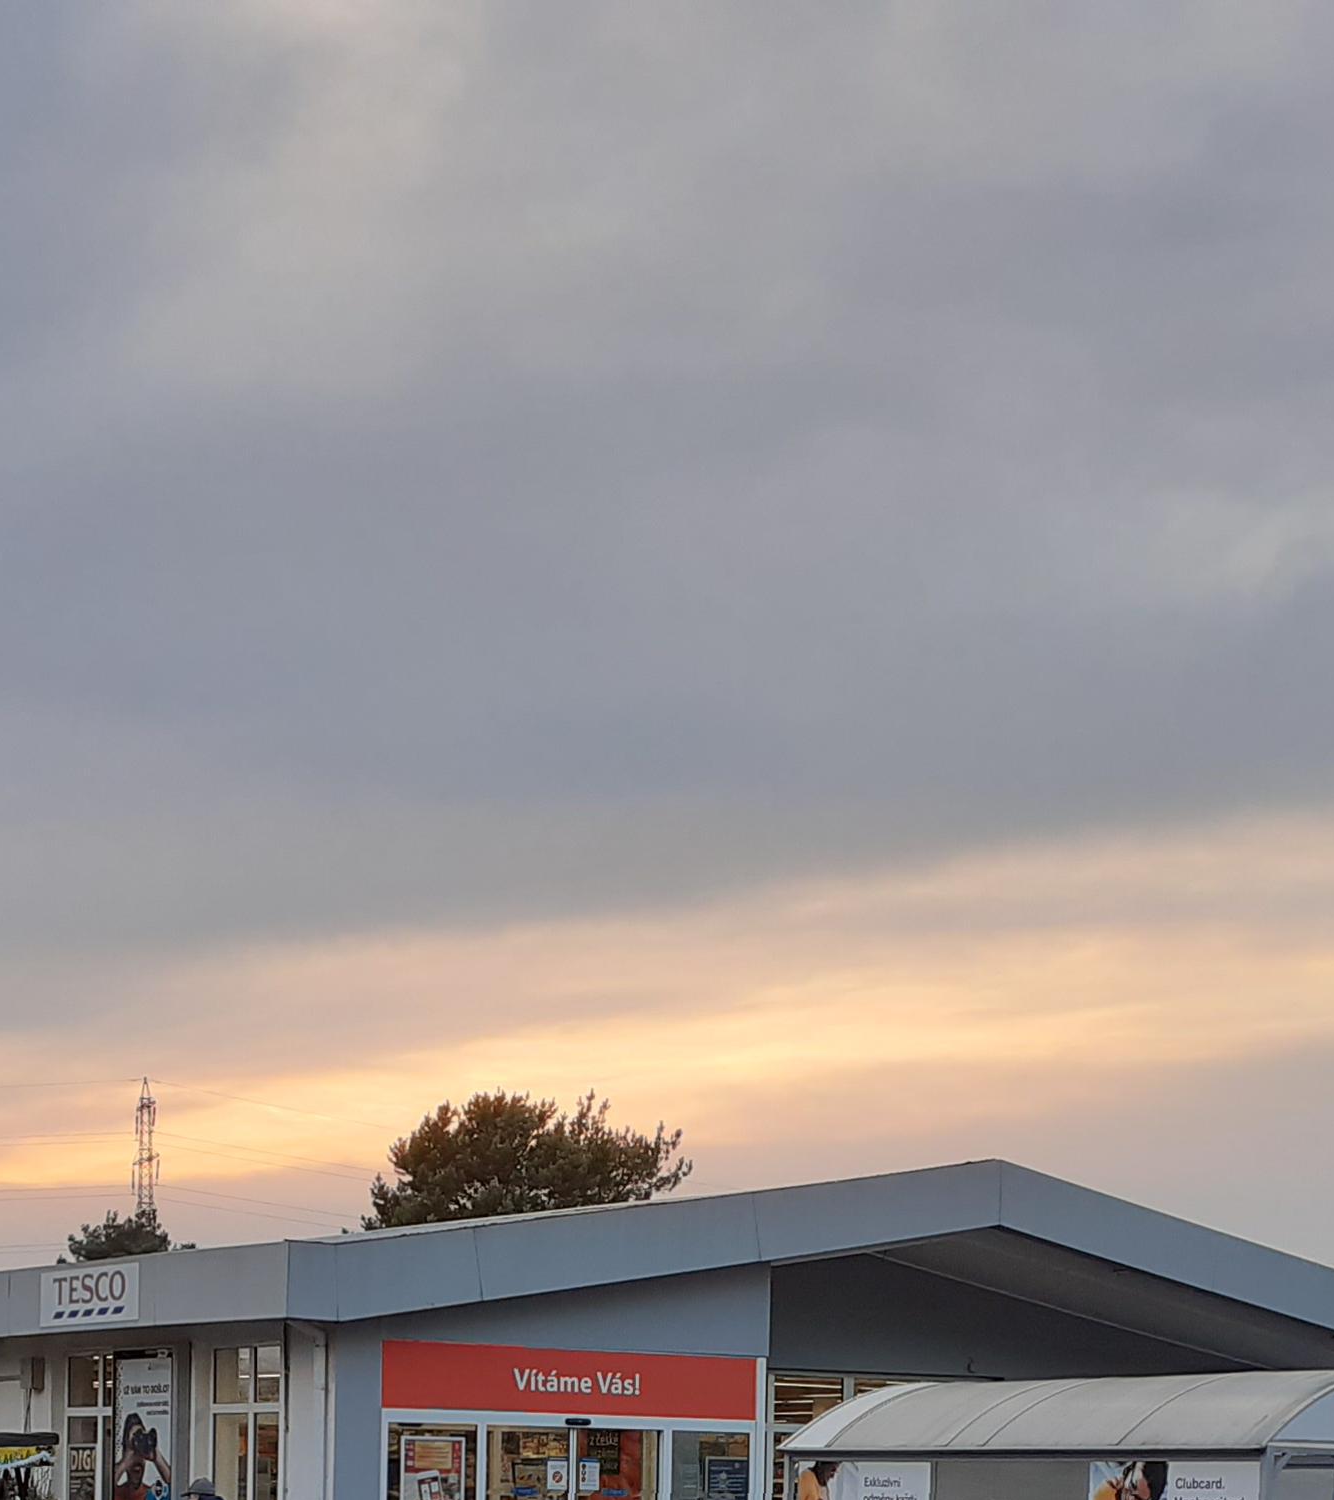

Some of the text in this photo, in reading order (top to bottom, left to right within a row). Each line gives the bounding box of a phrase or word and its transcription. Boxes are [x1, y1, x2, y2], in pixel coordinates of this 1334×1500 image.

[53, 1270, 126, 1305] TESCO
[513, 1368, 640, 1396] Vítáme Vás!
[1175, 1477, 1225, 1489] Clubcard.
